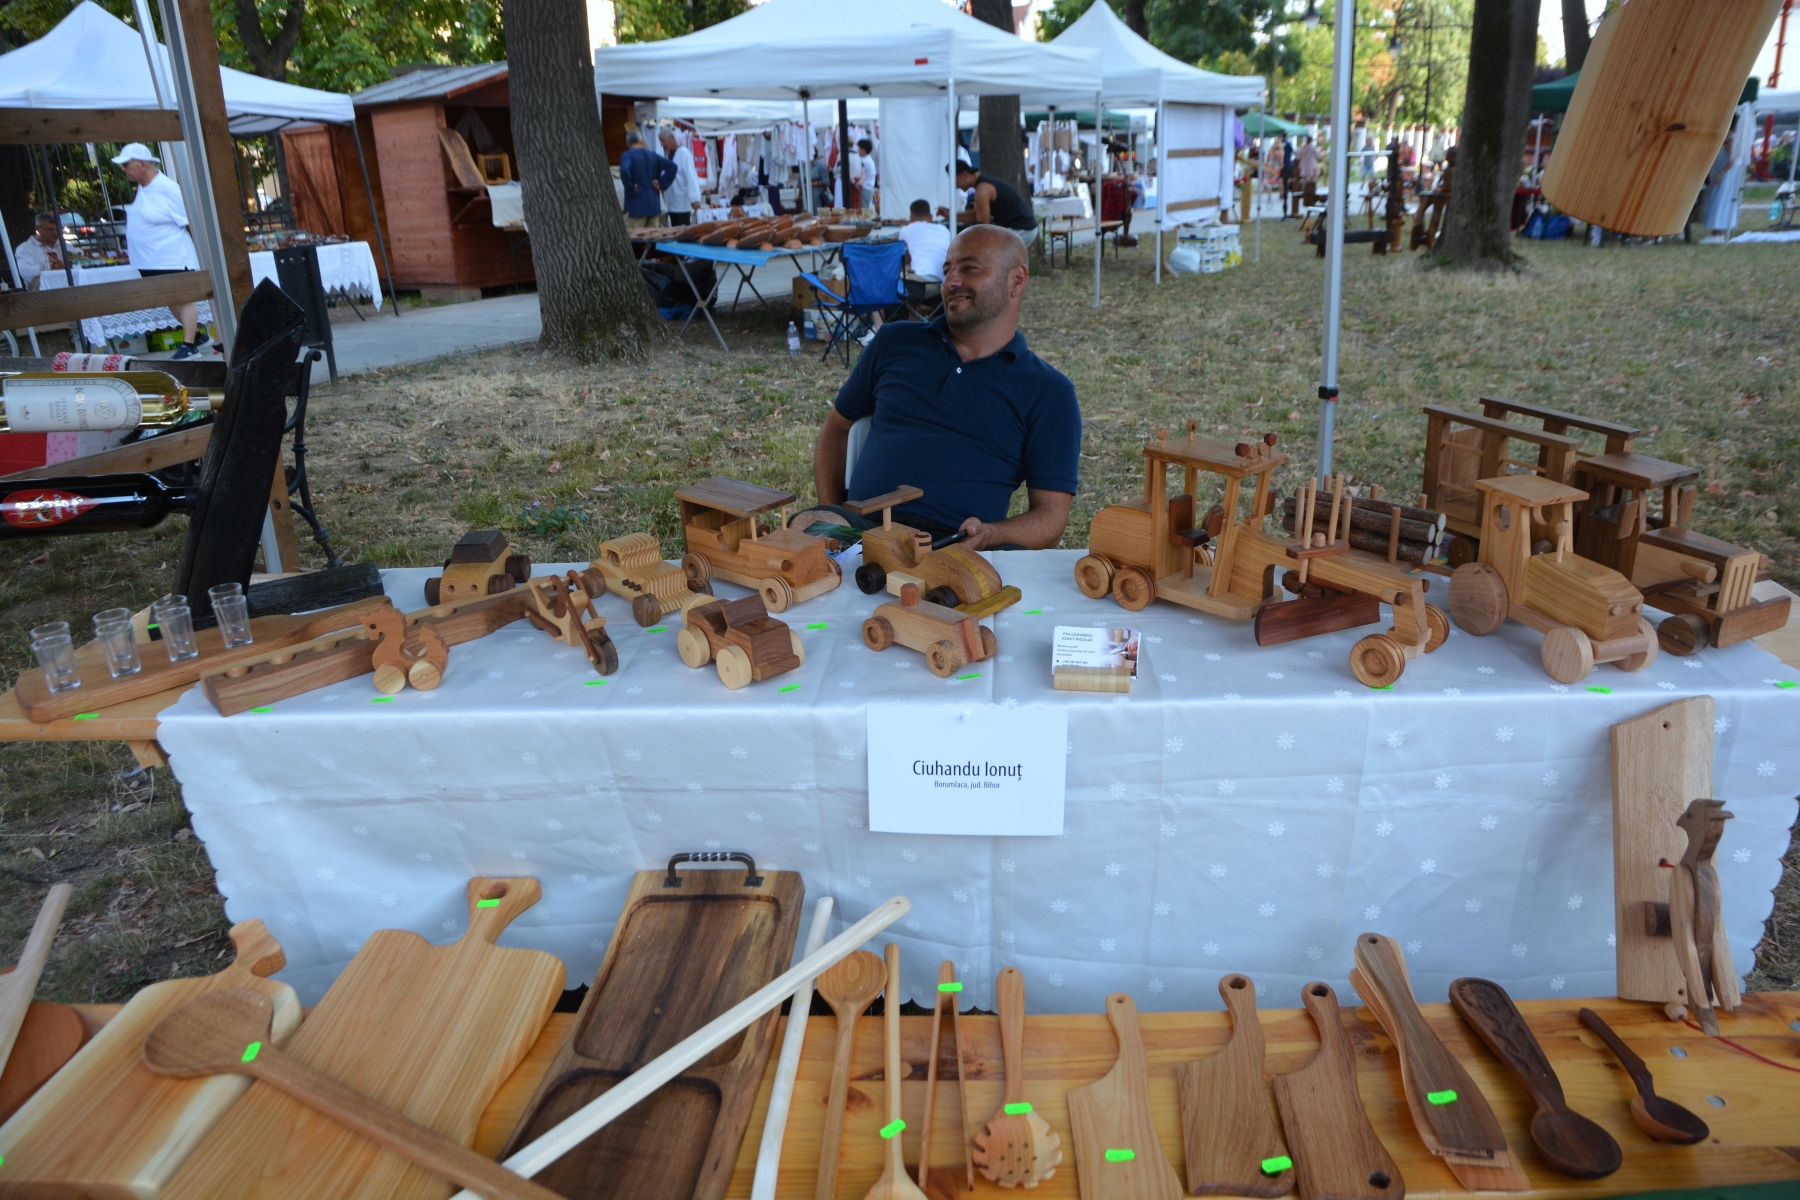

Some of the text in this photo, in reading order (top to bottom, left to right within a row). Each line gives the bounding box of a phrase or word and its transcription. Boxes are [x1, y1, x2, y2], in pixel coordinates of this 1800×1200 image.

[913, 760, 1023, 781] Ciuhandu Ionuț
[934, 780, 1001, 790] Borumlaca, jud. Bihor
